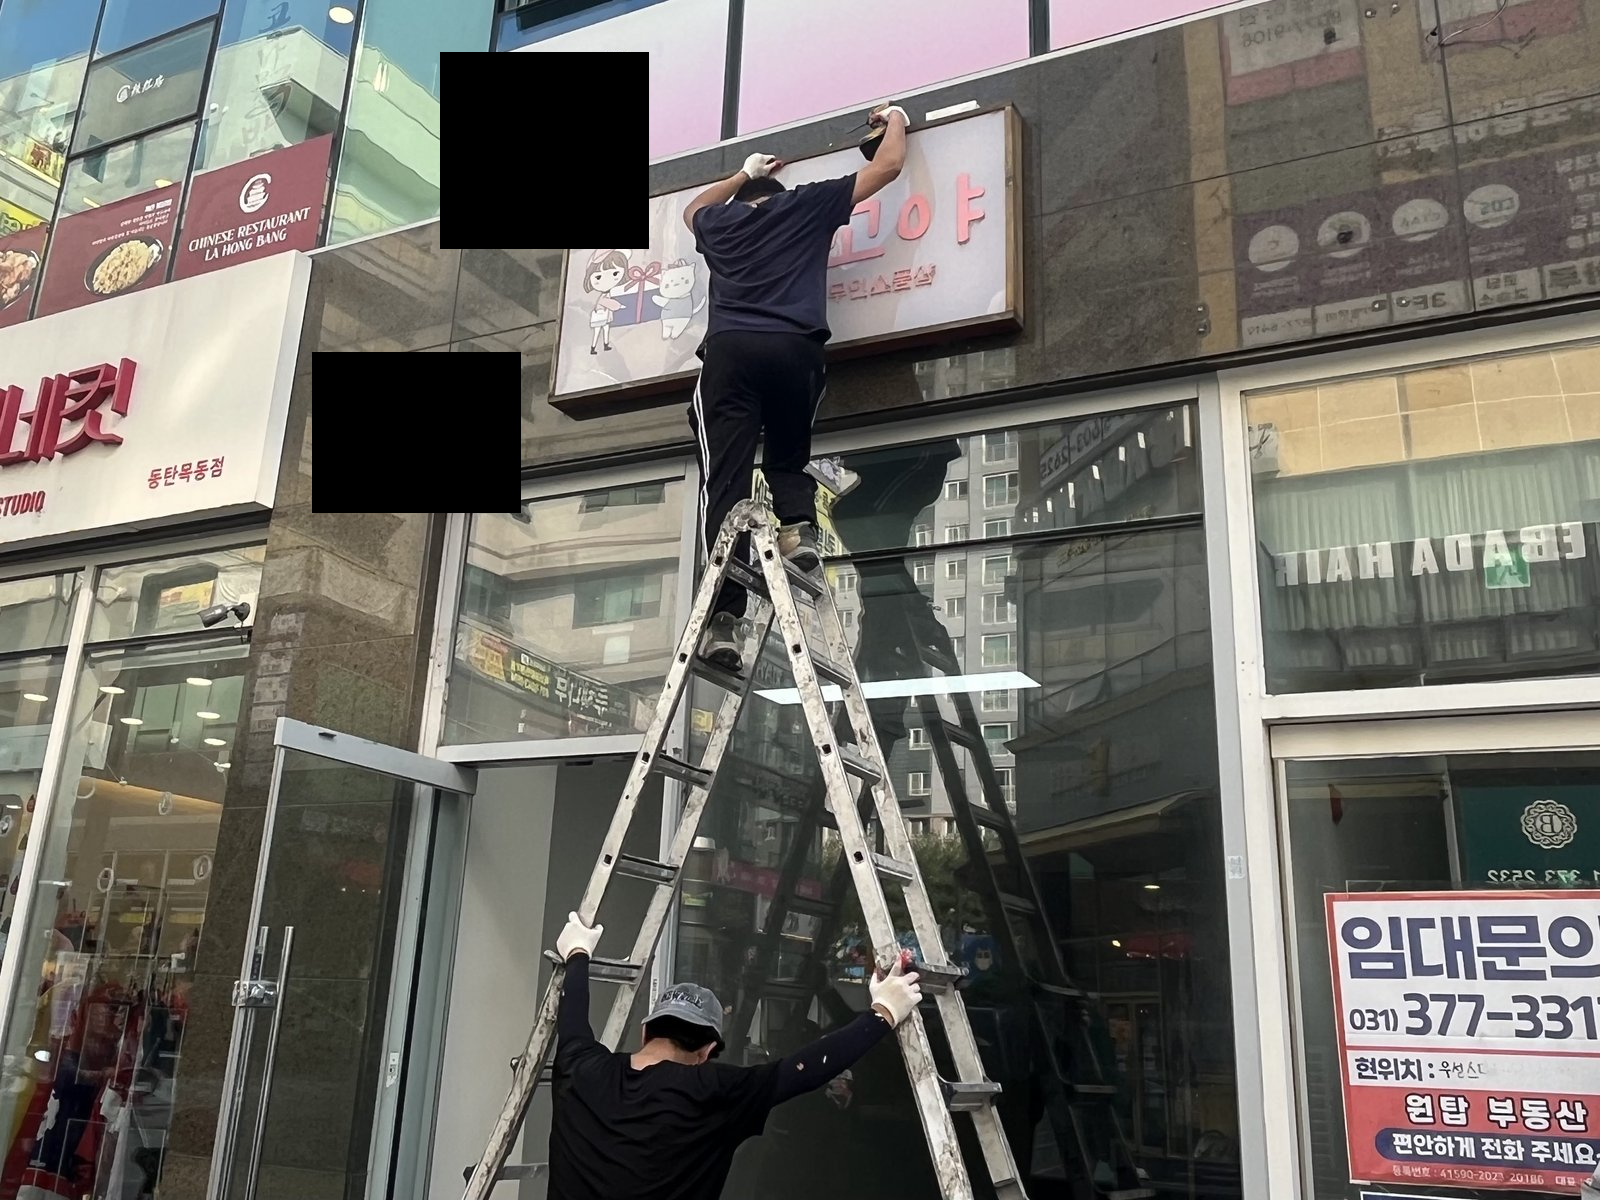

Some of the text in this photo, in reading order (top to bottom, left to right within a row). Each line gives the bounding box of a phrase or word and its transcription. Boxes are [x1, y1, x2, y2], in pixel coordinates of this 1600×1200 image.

[188, 229, 236, 252] CHINESE
[237, 207, 311, 237] RESTAURANT
[204, 228, 287, 261] LA HONG BANG
[0, 357, 137, 466] 네컷
[148, 456, 225, 489] 동탄목동점
[1341, 915, 1600, 981] 임대문의
[1349, 993, 1600, 1040] 031) 377-331
[1405, 1093, 1588, 1132] 원탑 부동산
[1393, 1133, 1600, 1165] 편안하게 전화 주세요
